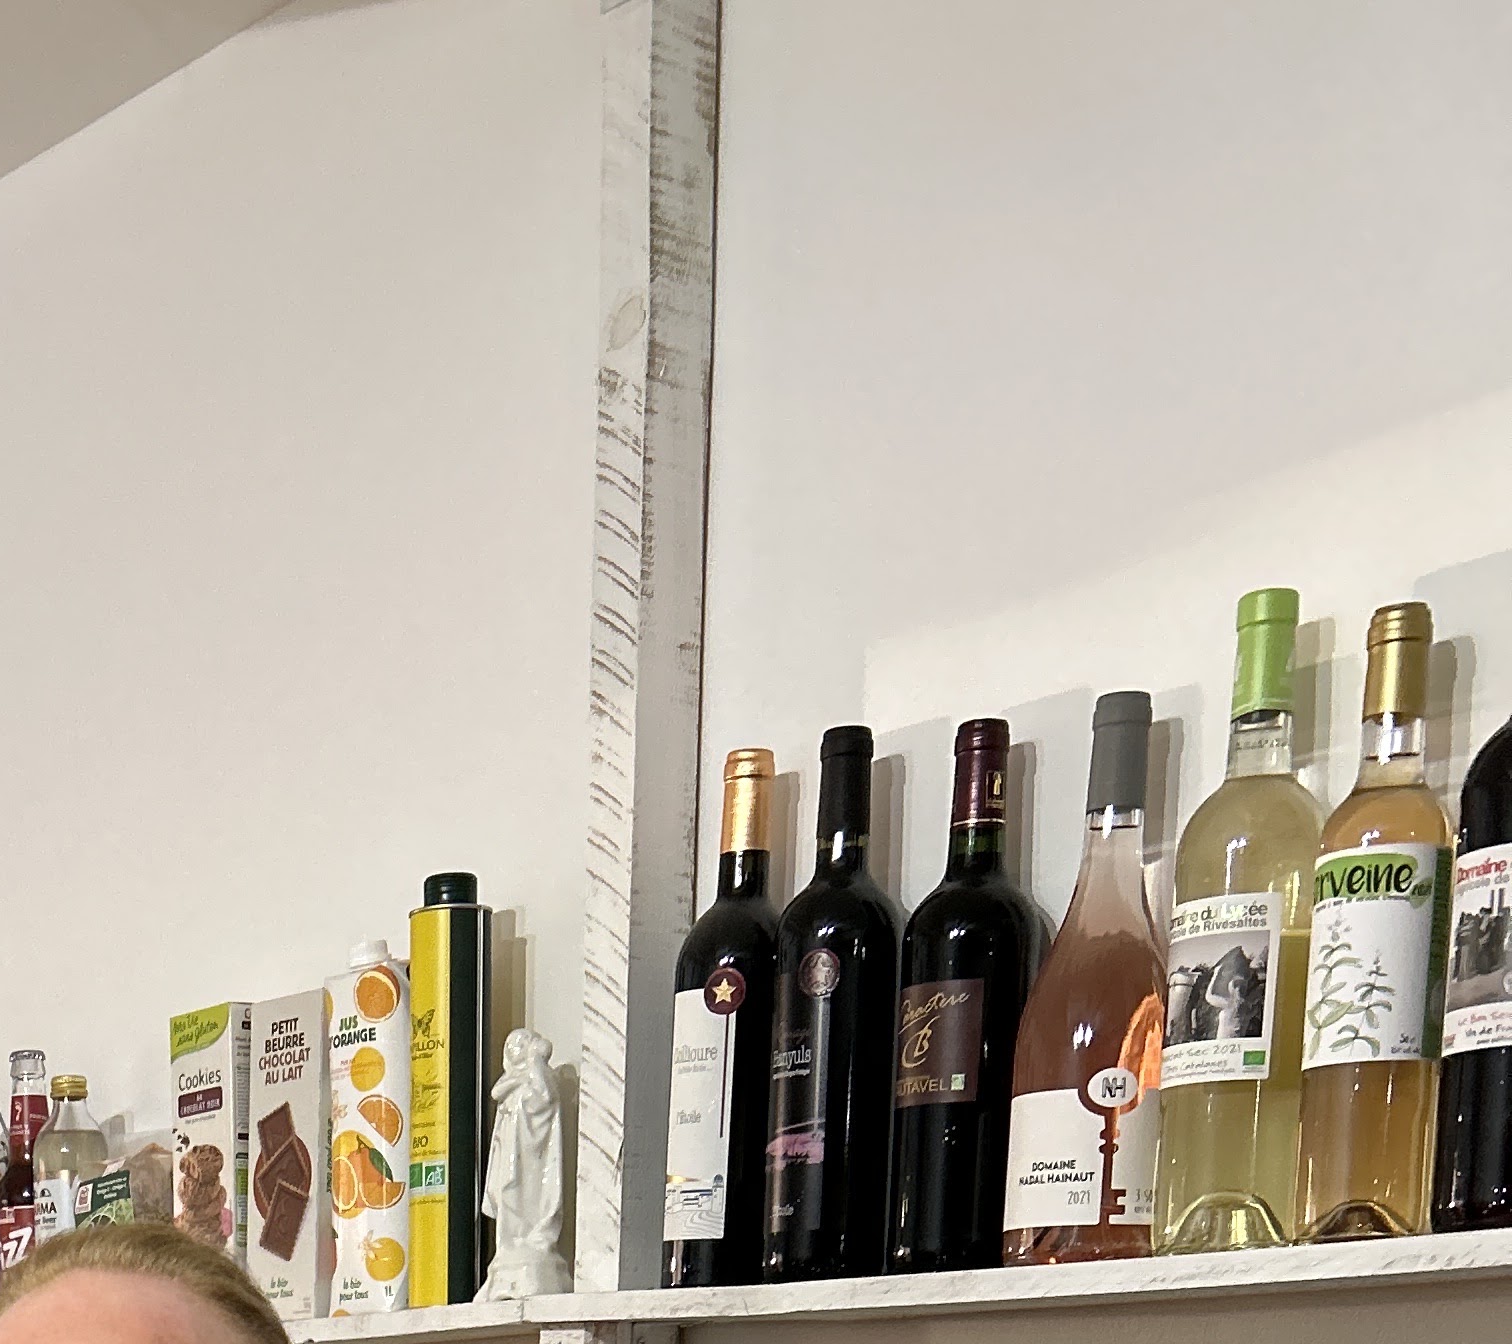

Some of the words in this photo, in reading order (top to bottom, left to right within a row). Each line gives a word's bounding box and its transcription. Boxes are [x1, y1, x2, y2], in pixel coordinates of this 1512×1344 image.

[271, 1017, 300, 1037] PETIT
[339, 1015, 359, 1032] JUS
[264, 1032, 306, 1054] BEURRE
[330, 1027, 377, 1050] 'ORANGE
[1212, 1043, 1242, 1056] 2021
[258, 1047, 311, 1071] CHOCOLAT
[178, 1068, 222, 1092] Cookies
[264, 1071, 281, 1086] AU
[282, 1065, 305, 1083] LAIT
[1031, 1159, 1077, 1173] DOMAINE
[1018, 1173, 1046, 1187] NADAL
[1047, 1171, 1095, 1184] HAINAUT
[1067, 1190, 1091, 1205] 2021
[350, 1277, 362, 1290] bio
[384, 1286, 394, 1297] 1L
[339, 1292, 354, 1305] pour
[354, 1290, 369, 1300] tous
